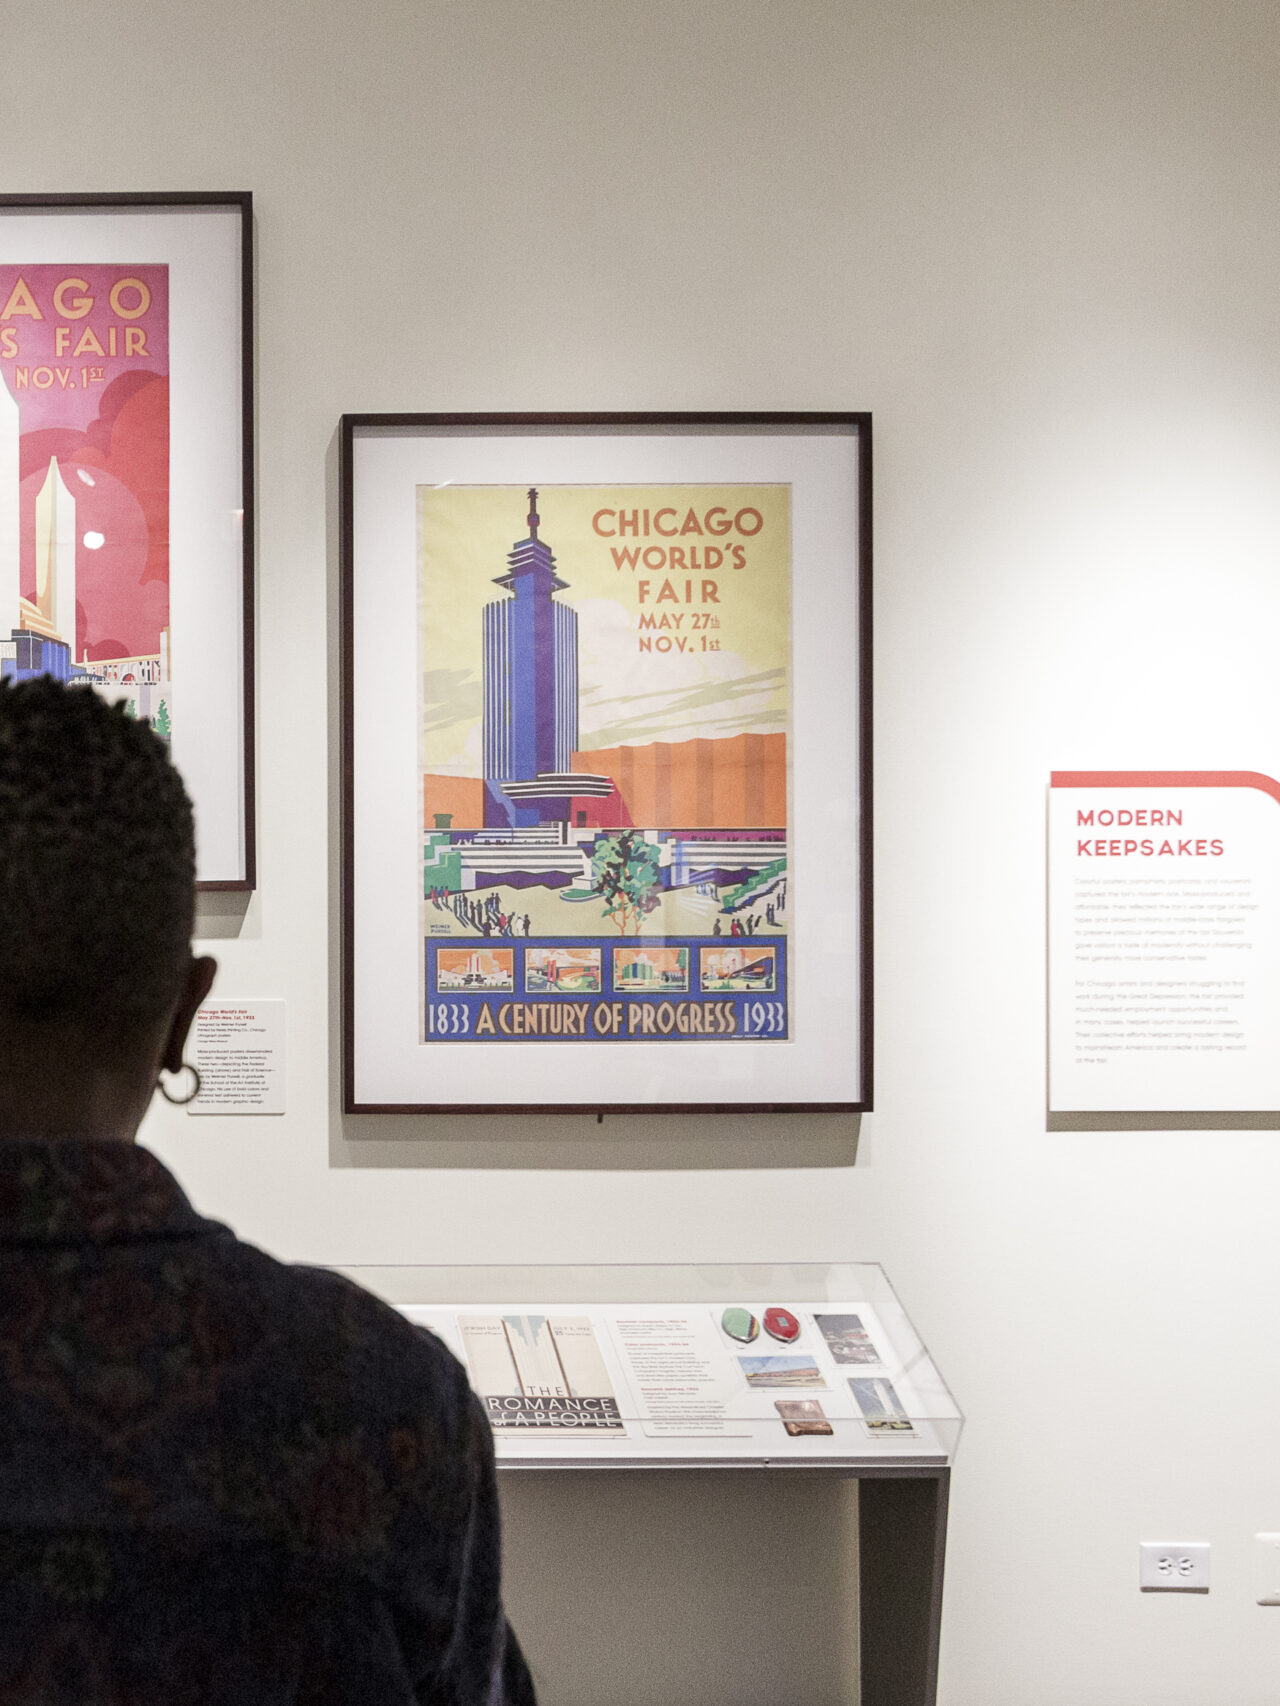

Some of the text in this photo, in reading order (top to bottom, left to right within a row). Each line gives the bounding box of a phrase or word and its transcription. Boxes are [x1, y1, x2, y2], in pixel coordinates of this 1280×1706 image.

[54, 326, 151, 358] FAIR
[15, 366, 76, 389] NOV.
[592, 506, 764, 537] CHICAGO
[610, 543, 747, 572] WORLD'S
[638, 578, 721, 604] FAIR
[638, 612, 685, 630] MAY
[639, 635, 695, 654] NOV.
[1076, 809, 1184, 827] MODERN
[1076, 838, 1226, 857] KEEPSAKES
[428, 1001, 785, 1034] 1833 A CENTURY OF PROGRESS 1933
[527, 1385, 565, 1397] THE
[487, 1397, 613, 1411] ROMANCE
[516, 1411, 531, 1426] A
[533, 1411, 618, 1427] PEOPLE
